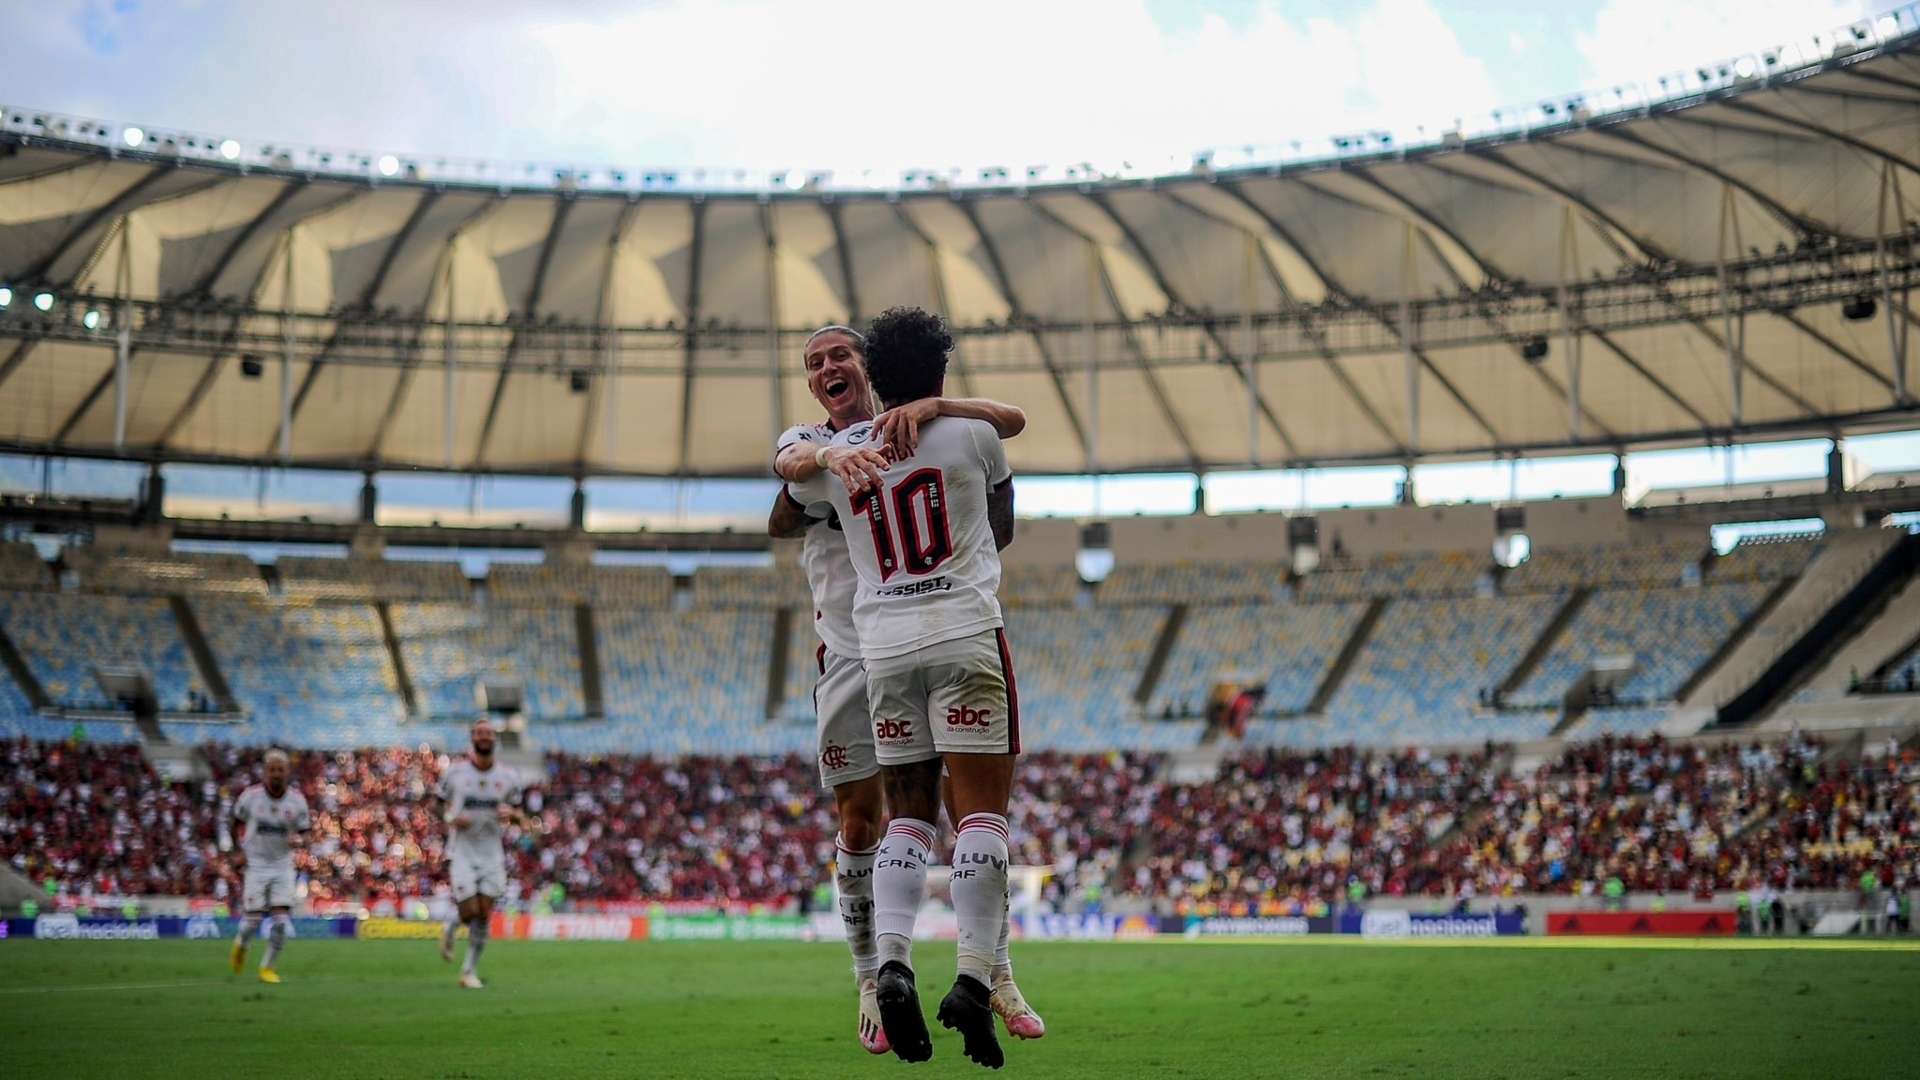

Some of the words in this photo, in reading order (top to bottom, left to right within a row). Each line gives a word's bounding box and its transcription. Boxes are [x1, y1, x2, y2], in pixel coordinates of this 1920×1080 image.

[849, 467, 954, 584] 10
[947, 705, 991, 727] abc
[877, 719, 913, 739] abc
[878, 860, 917, 870] CRF
